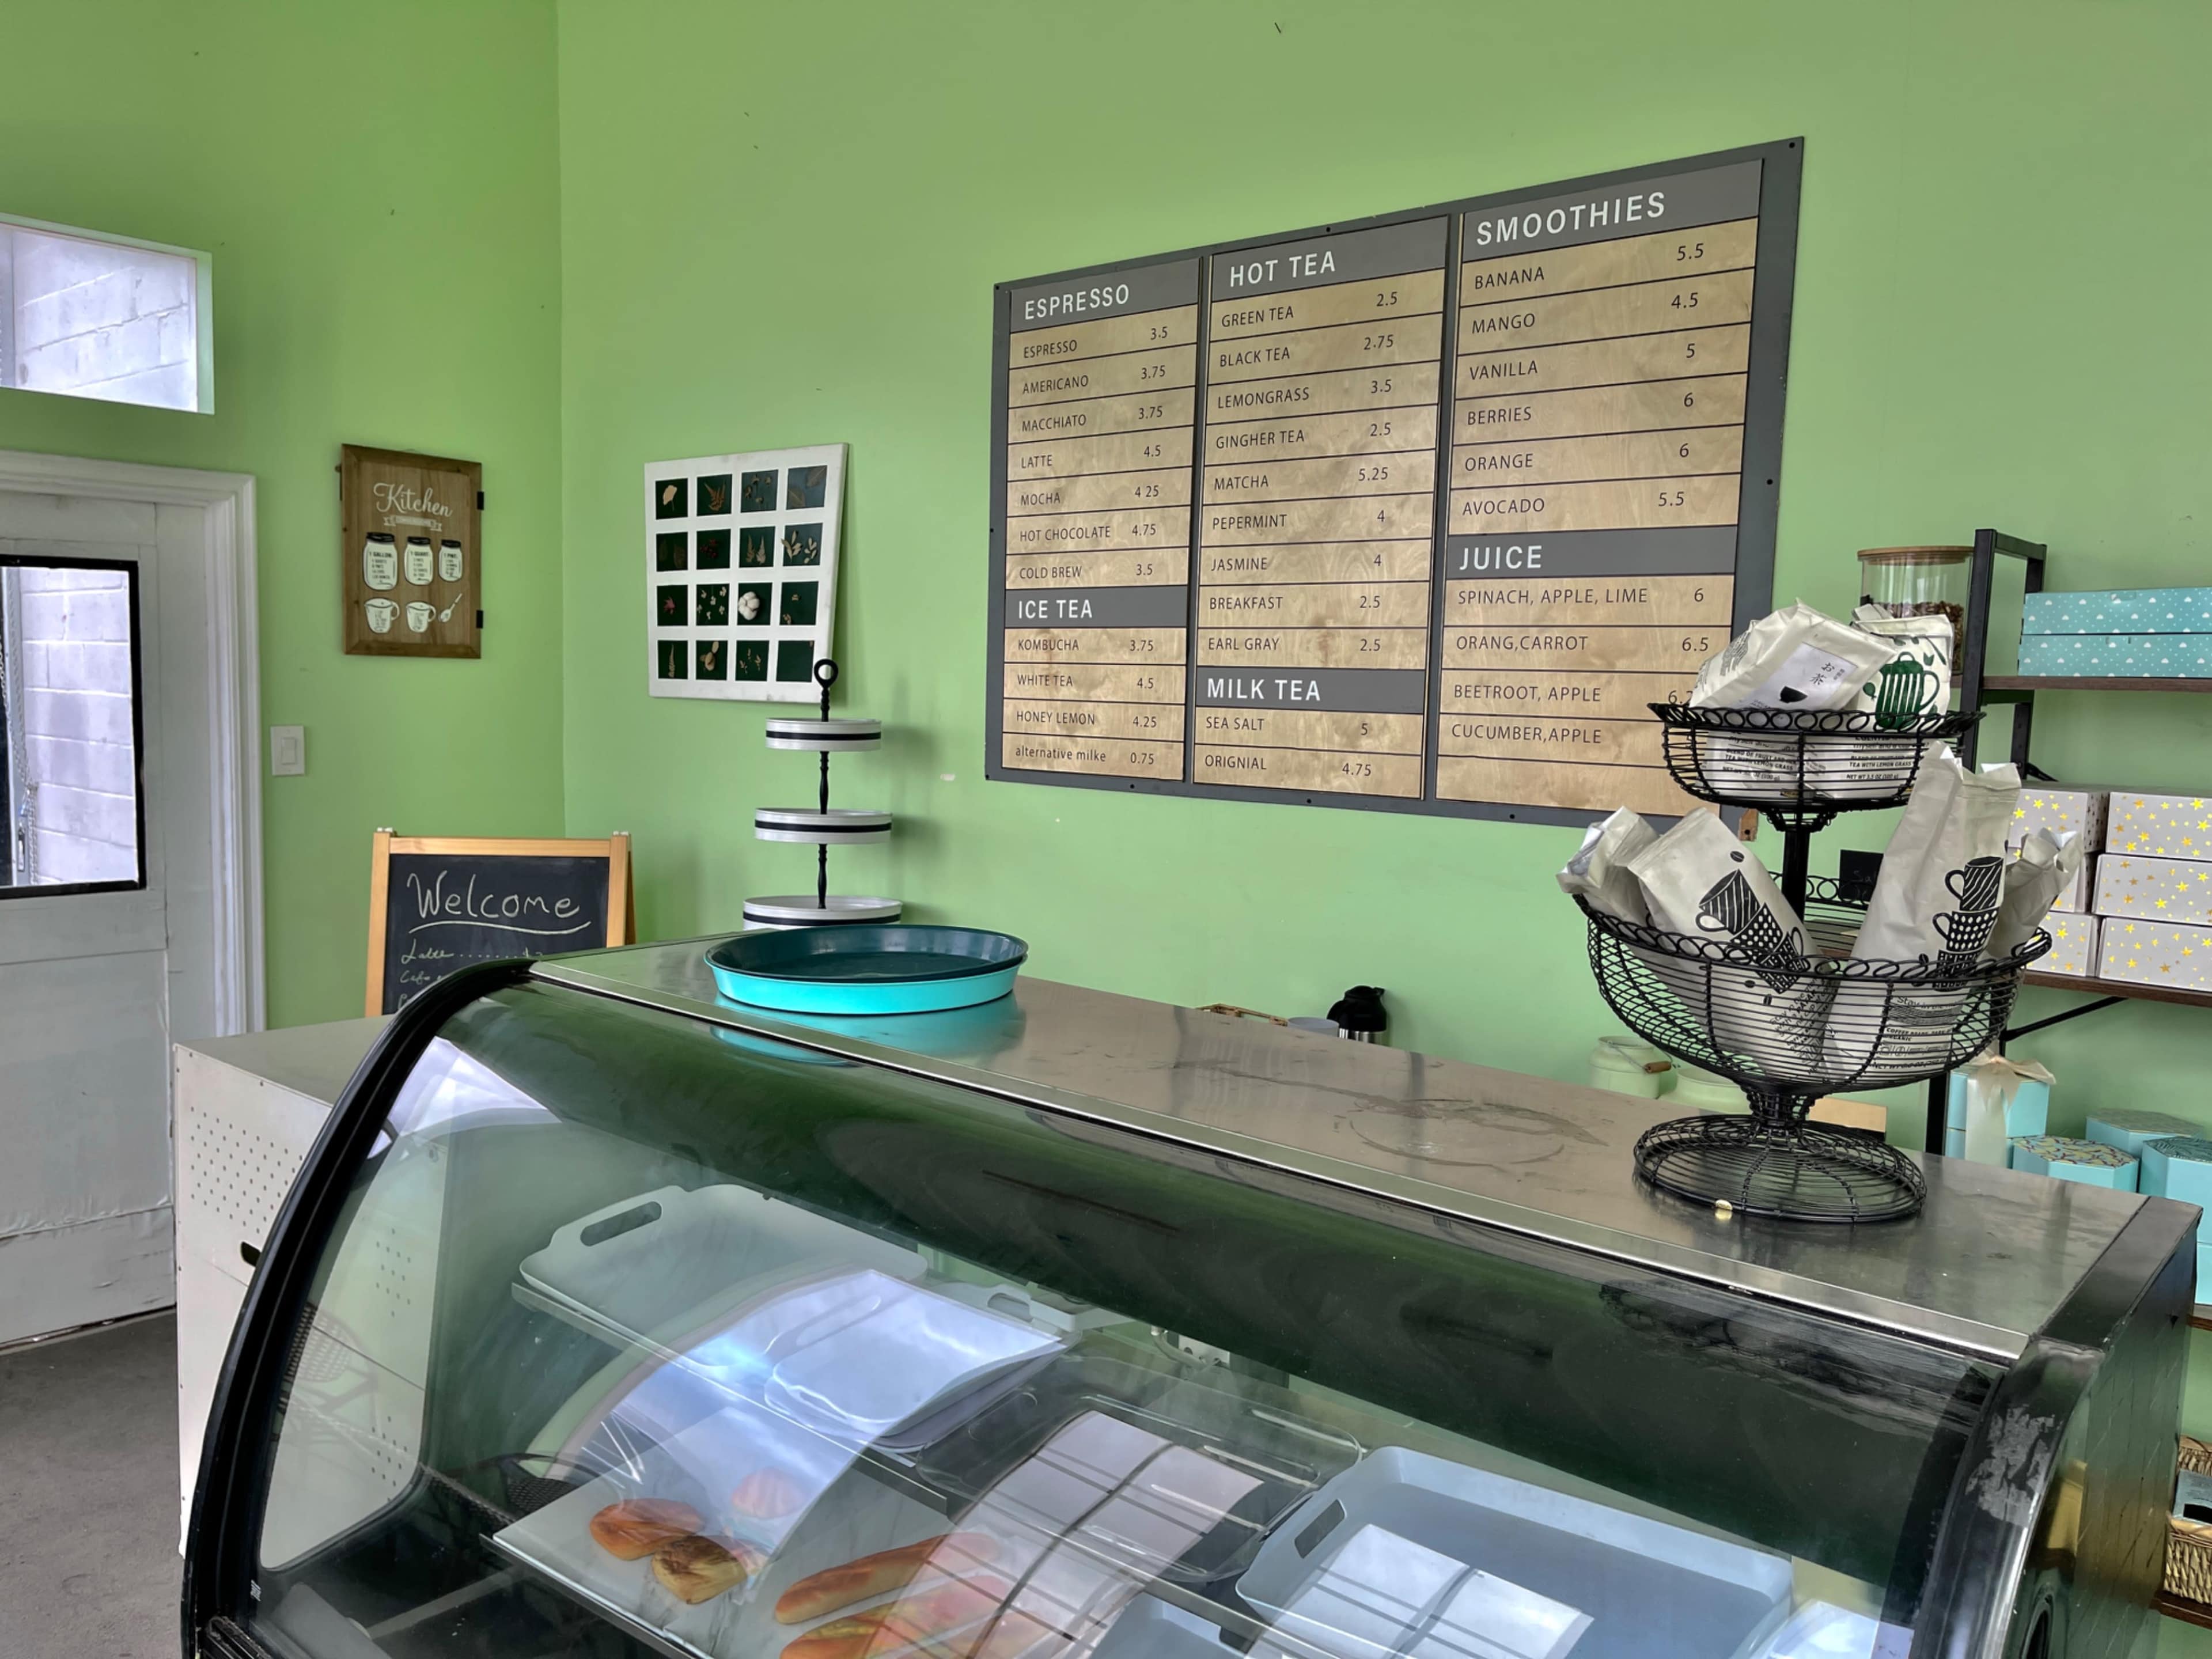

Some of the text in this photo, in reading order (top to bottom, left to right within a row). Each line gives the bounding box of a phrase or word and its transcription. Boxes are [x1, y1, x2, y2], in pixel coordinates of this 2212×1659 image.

[1475, 191, 1666, 247] SMOOTHIES
[1230, 251, 1335, 287] HOT TEA
[1475, 243, 1704, 290] BANANA 5.5
[1024, 284, 1130, 321] ESPRESSO
[1221, 291, 1397, 328] GREEN TEA 2.5
[1472, 292, 1698, 334] MANGO 4.5
[1023, 326, 1168, 359] ESPRESSO 3.5
[1219, 334, 1393, 368] BLACK TEA 2.75
[1469, 343, 1695, 380] VANILLA 5
[1022, 365, 1165, 394] AMERICANO 3.75
[1218, 379, 1392, 409] LEMONGRASS 3.5
[1022, 405, 1162, 432] MACCHIATO 3.75
[1468, 392, 1694, 426] BERRIES 6
[1216, 422, 1391, 449] GINGHER TEA 2.5
[1021, 445, 1161, 469] LATTE 4.5
[1465, 442, 1689, 471] ORANGE 6
[1214, 467, 1388, 491] MATCHA 5.25
[373, 482, 453, 517] Kitchen
[1021, 491, 1060, 506] MOCHA
[1462, 491, 1684, 516] AVOCADO 5.5
[1213, 510, 1385, 530] PEPERMINT 4
[1020, 524, 1156, 541] HOT CHOCOLATE 4.75
[1211, 554, 1381, 571] JASMINE 4
[1459, 545, 1542, 570] JUICE
[1020, 563, 1153, 579] COLD BREW 3.5
[1210, 595, 1380, 610] BREAKFAST 2.5
[1458, 588, 1704, 605] SPINACH, APPLE, LIME 6
[1018, 599, 1093, 619] ICE TEA
[1018, 639, 1154, 652] KOMBUCHA 3.75
[1209, 638, 1381, 652] EARL GRAY 2.5
[1682, 637, 1709, 652] 6.5
[1017, 674, 1154, 690] WHITE TEA 4.5
[1207, 678, 1320, 701] MILK TEA
[1454, 684, 1541, 702] BEETROOT,
[1548, 687, 1601, 702] APPLE
[1016, 710, 1157, 728] HONEY LEMON 4.25
[1206, 716, 1368, 736] SEA SALT 5
[1016, 745, 1154, 765] alternative milke 0.75
[1205, 754, 1371, 777] ORIGNIAL 4.75
[407, 870, 579, 919] Welcome
